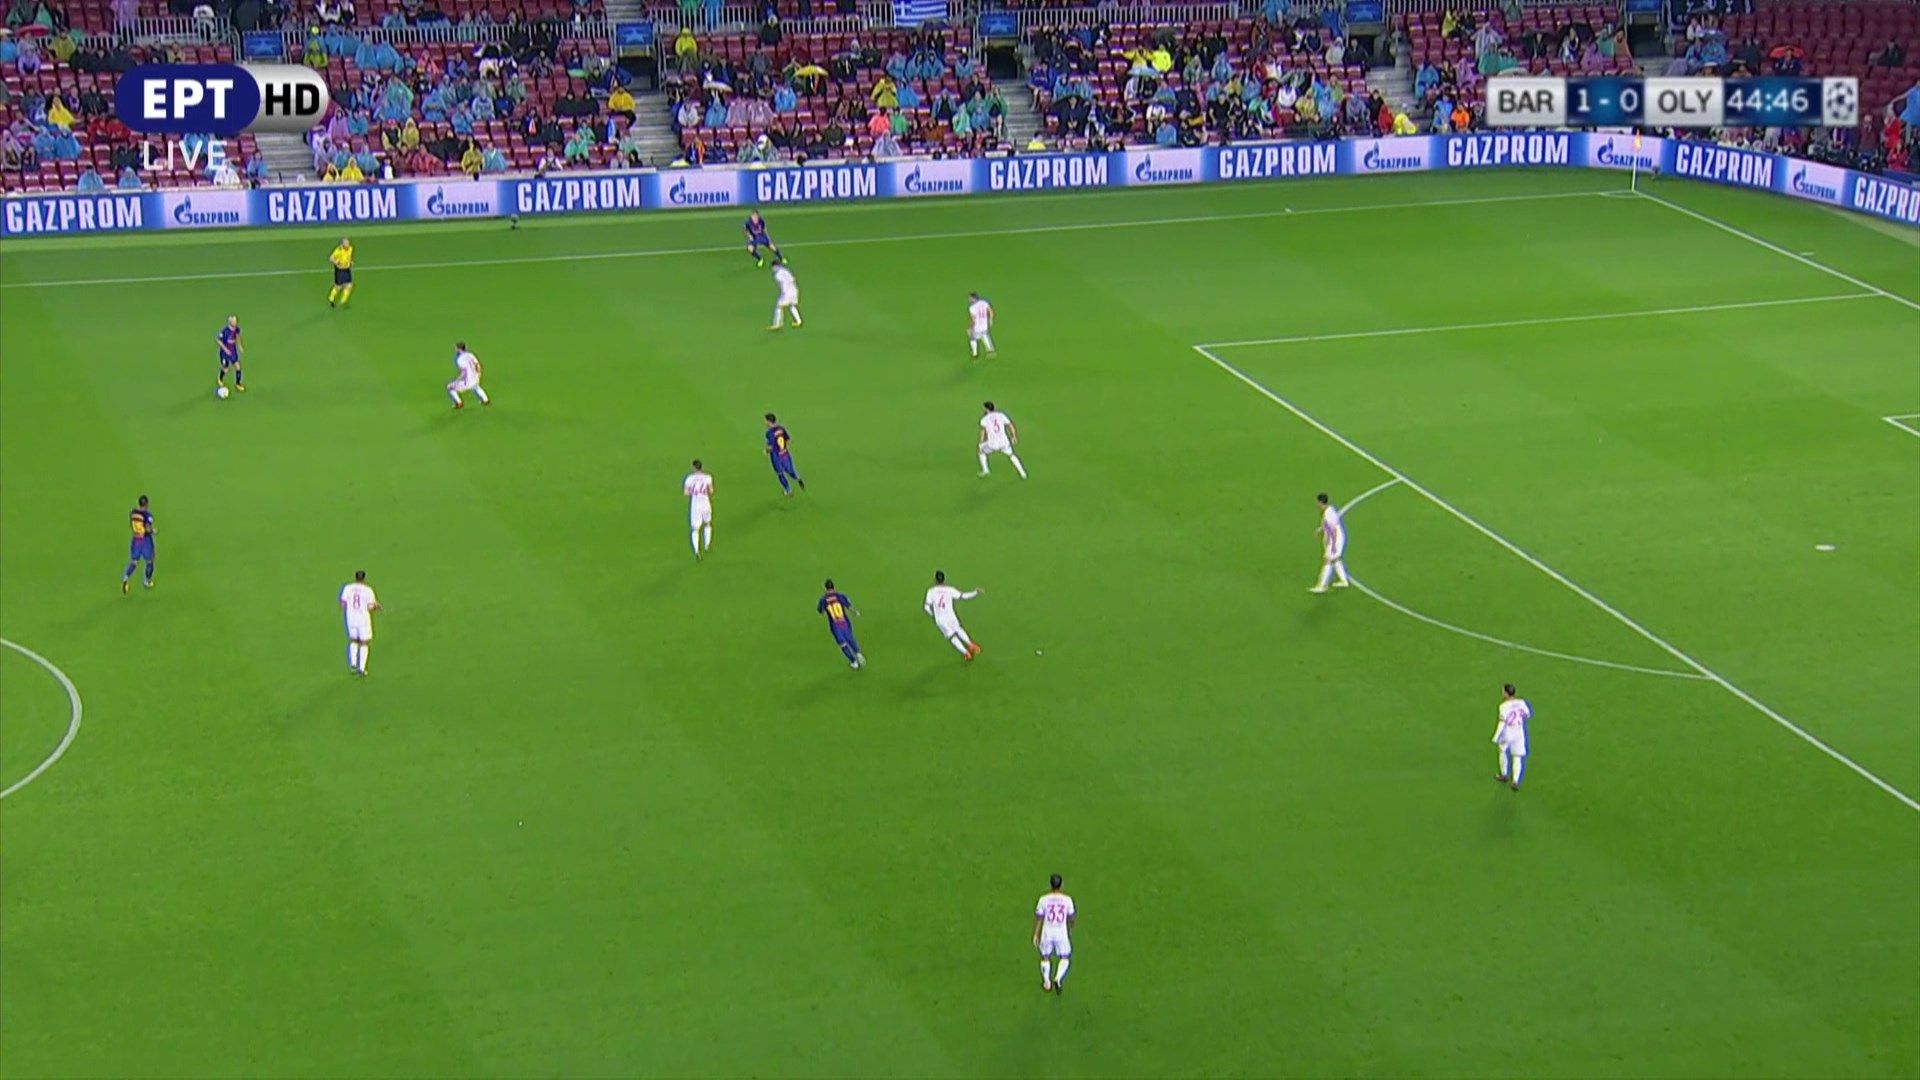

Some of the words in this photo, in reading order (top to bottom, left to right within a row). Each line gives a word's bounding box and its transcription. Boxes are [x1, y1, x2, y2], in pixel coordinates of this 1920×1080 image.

[1220, 144, 1336, 178] GAZPROM
[1380, 156, 1421, 169] GAZPROM
[1448, 135, 1569, 166] GAZPROM
[990, 157, 1108, 190] GAZPROM
[1151, 168, 1193, 181] GAZPROM
[1676, 144, 1773, 188] GAZPROM
[517, 178, 641, 212] GAZPROM
[757, 167, 876, 201] GAZPROM
[921, 180, 963, 192] GAZPROM
[268, 188, 398, 223] GAZPROM
[444, 202, 489, 215] GAZPROM
[685, 191, 730, 204] GAZPROM
[6, 196, 143, 233] GAZPROM
[193, 211, 240, 225] GAZPROM
[826, 601, 845, 621] 10
[1047, 904, 1065, 923] 33
